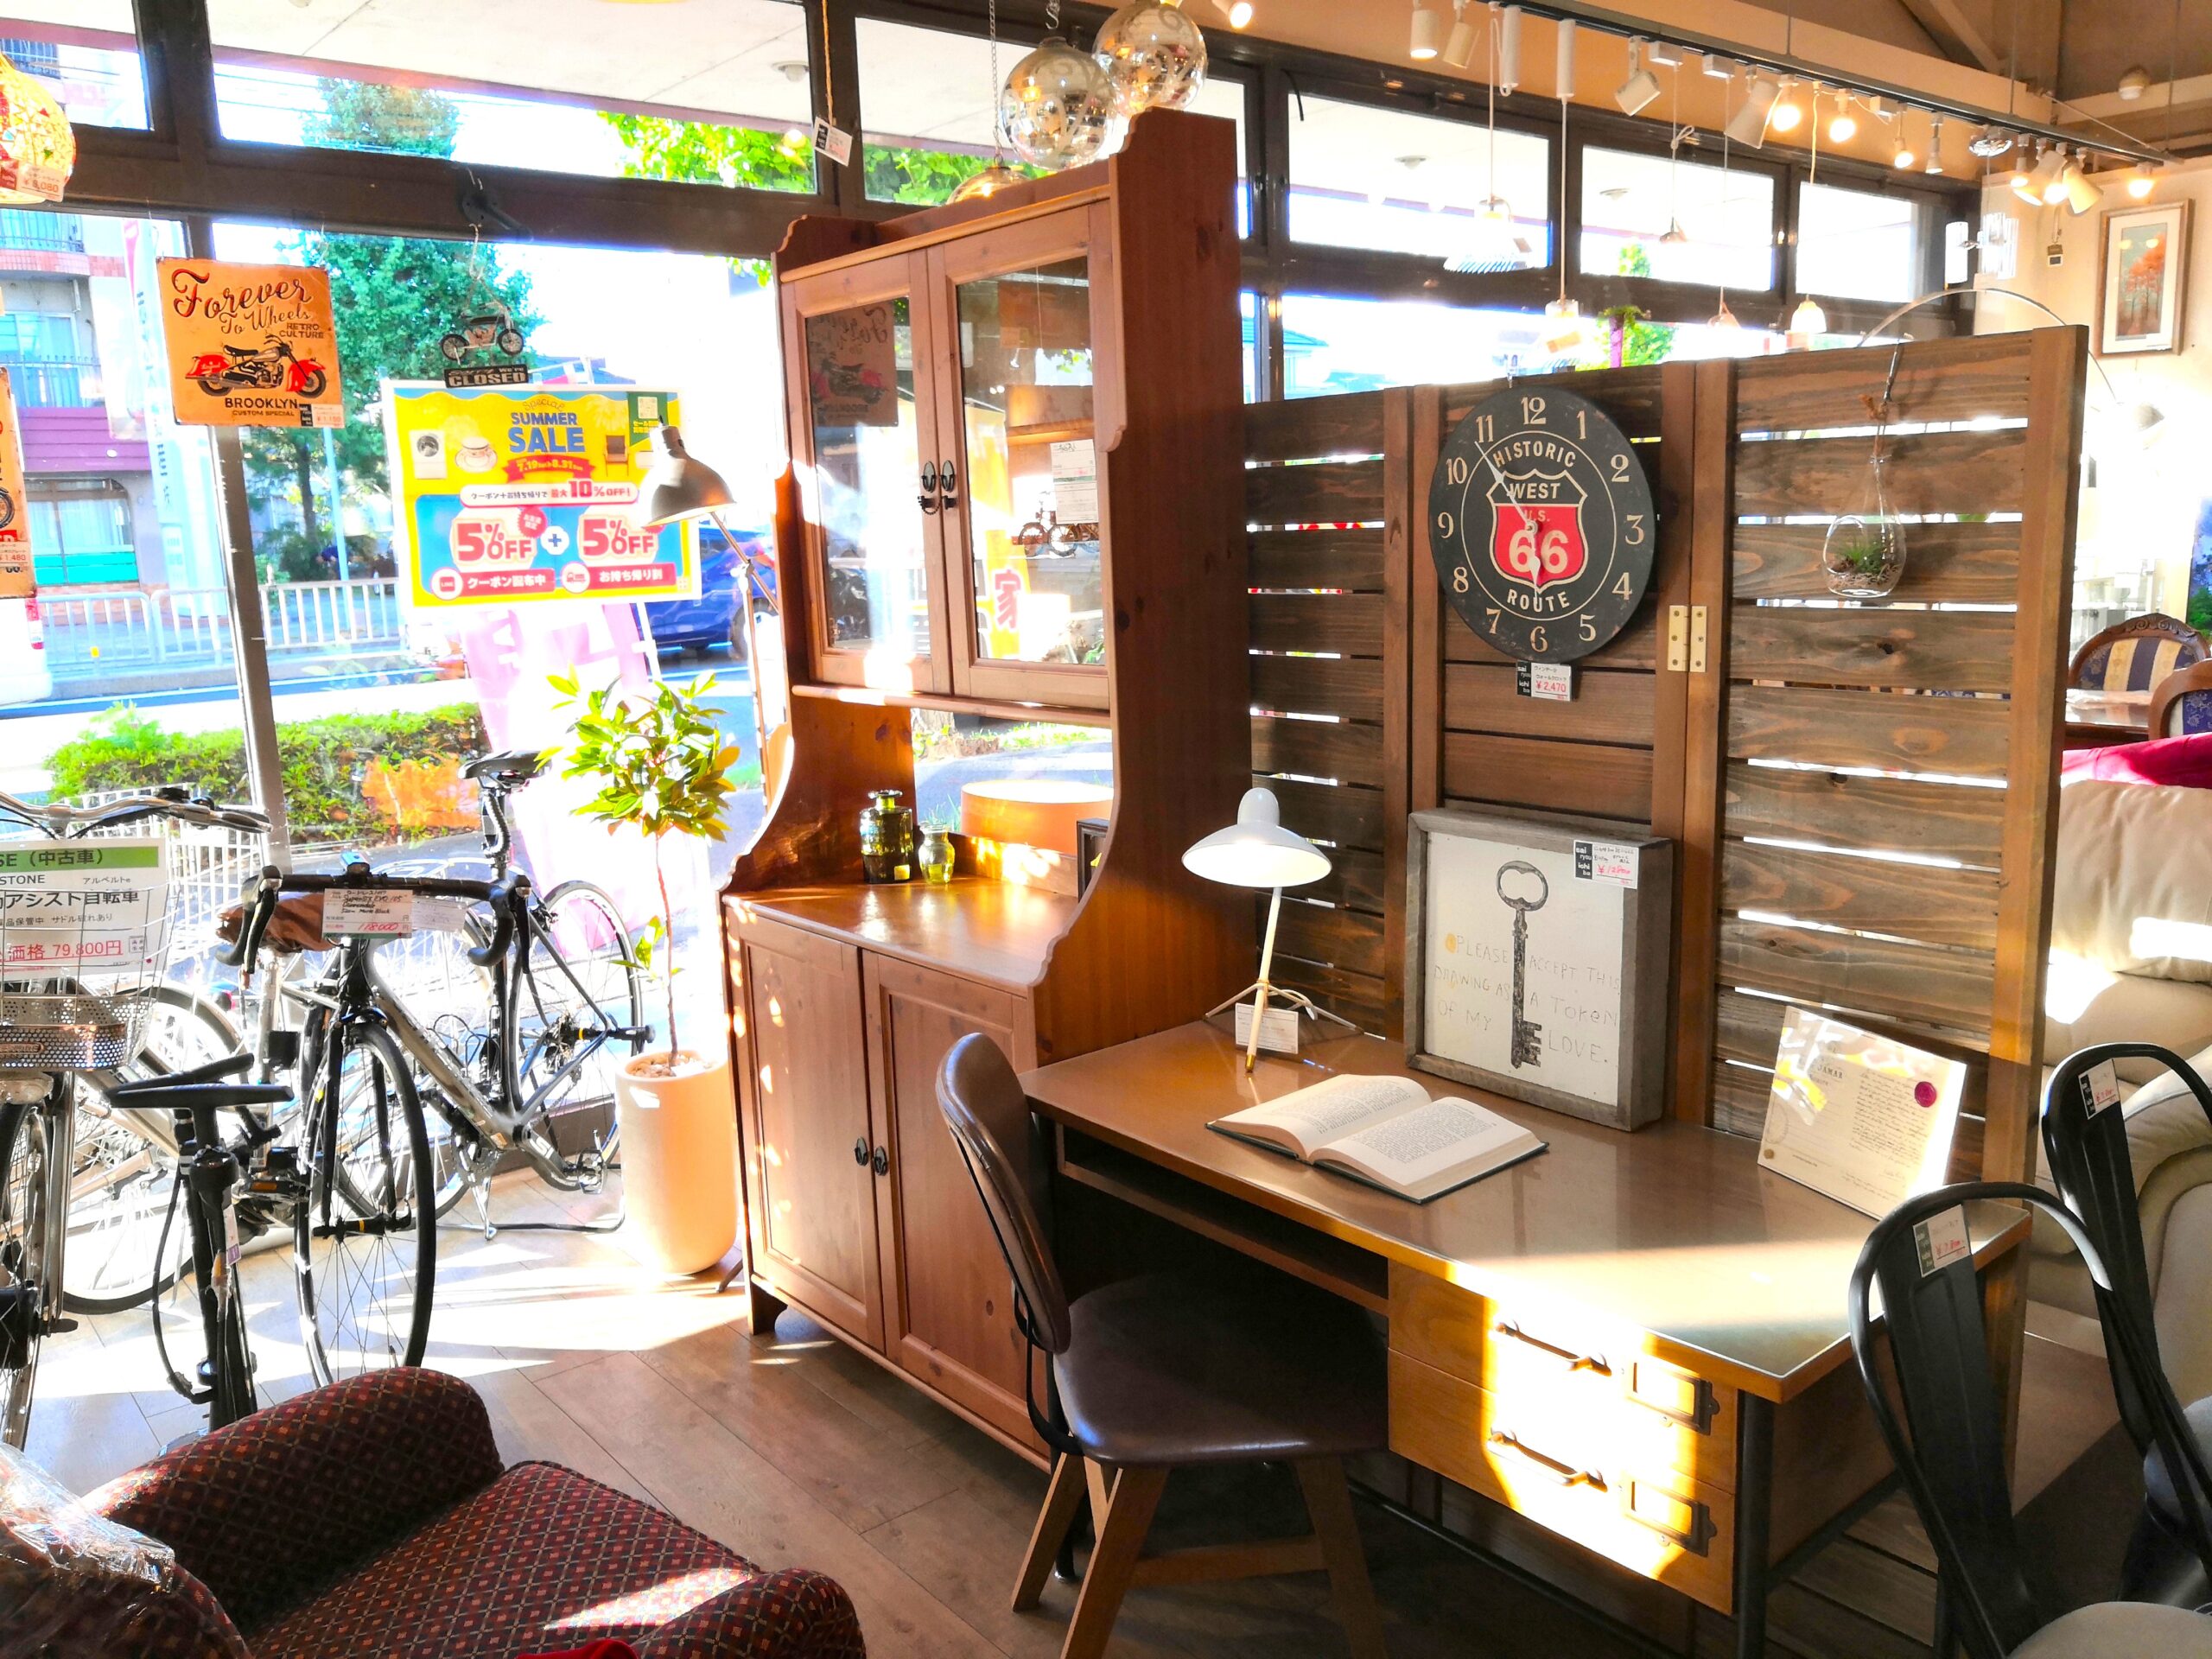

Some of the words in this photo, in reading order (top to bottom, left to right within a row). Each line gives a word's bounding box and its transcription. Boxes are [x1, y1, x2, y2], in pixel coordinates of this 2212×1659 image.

[171, 268, 312, 319] Forever
[219, 312, 245, 334] To
[245, 302, 311, 331] Wheels
[286, 322, 320, 331] RETRO
[279, 329, 324, 340] CULTURE
[448, 372, 526, 387] CLOSED
[225, 397, 298, 409] BROOKLYN
[523, 398, 566, 413] Special
[1521, 397, 1547, 424] 12
[511, 412, 577, 426] SUMMER
[1476, 415, 1493, 443] 11
[1577, 410, 1586, 440] 1
[508, 427, 586, 453] SALE
[1492, 441, 1577, 468] HISTORIC
[1611, 454, 1630, 482] 2
[1446, 457, 1467, 485] 10
[1509, 482, 1560, 500] WEST
[1437, 512, 1454, 539] 9
[1523, 509, 1550, 522] U.S.
[1625, 515, 1644, 545] 3
[487, 540, 532, 561] OFF
[612, 535, 654, 555] OFF
[1509, 529, 1570, 575] 66
[1452, 566, 1469, 593] 8
[1612, 572, 1632, 601] 4
[1507, 588, 1570, 613] ROUTE
[1486, 608, 1502, 635] 7
[1579, 614, 1596, 642] 5
[1530, 626, 1548, 652] 6
[0, 874, 46, 886] STONE
[0, 917, 44, 926] 品保管中
[52, 939, 121, 957] 79,800円
[1457, 935, 1508, 963] PLEASE
[1529, 955, 1576, 980] ACCEPT
[1586, 966, 1619, 989] THIS
[1433, 964, 1491, 991] DRAWING
[1496, 982, 1510, 1001] AS
[1529, 991, 1539, 1008] A
[1548, 1029, 1607, 1063] LOVE.
